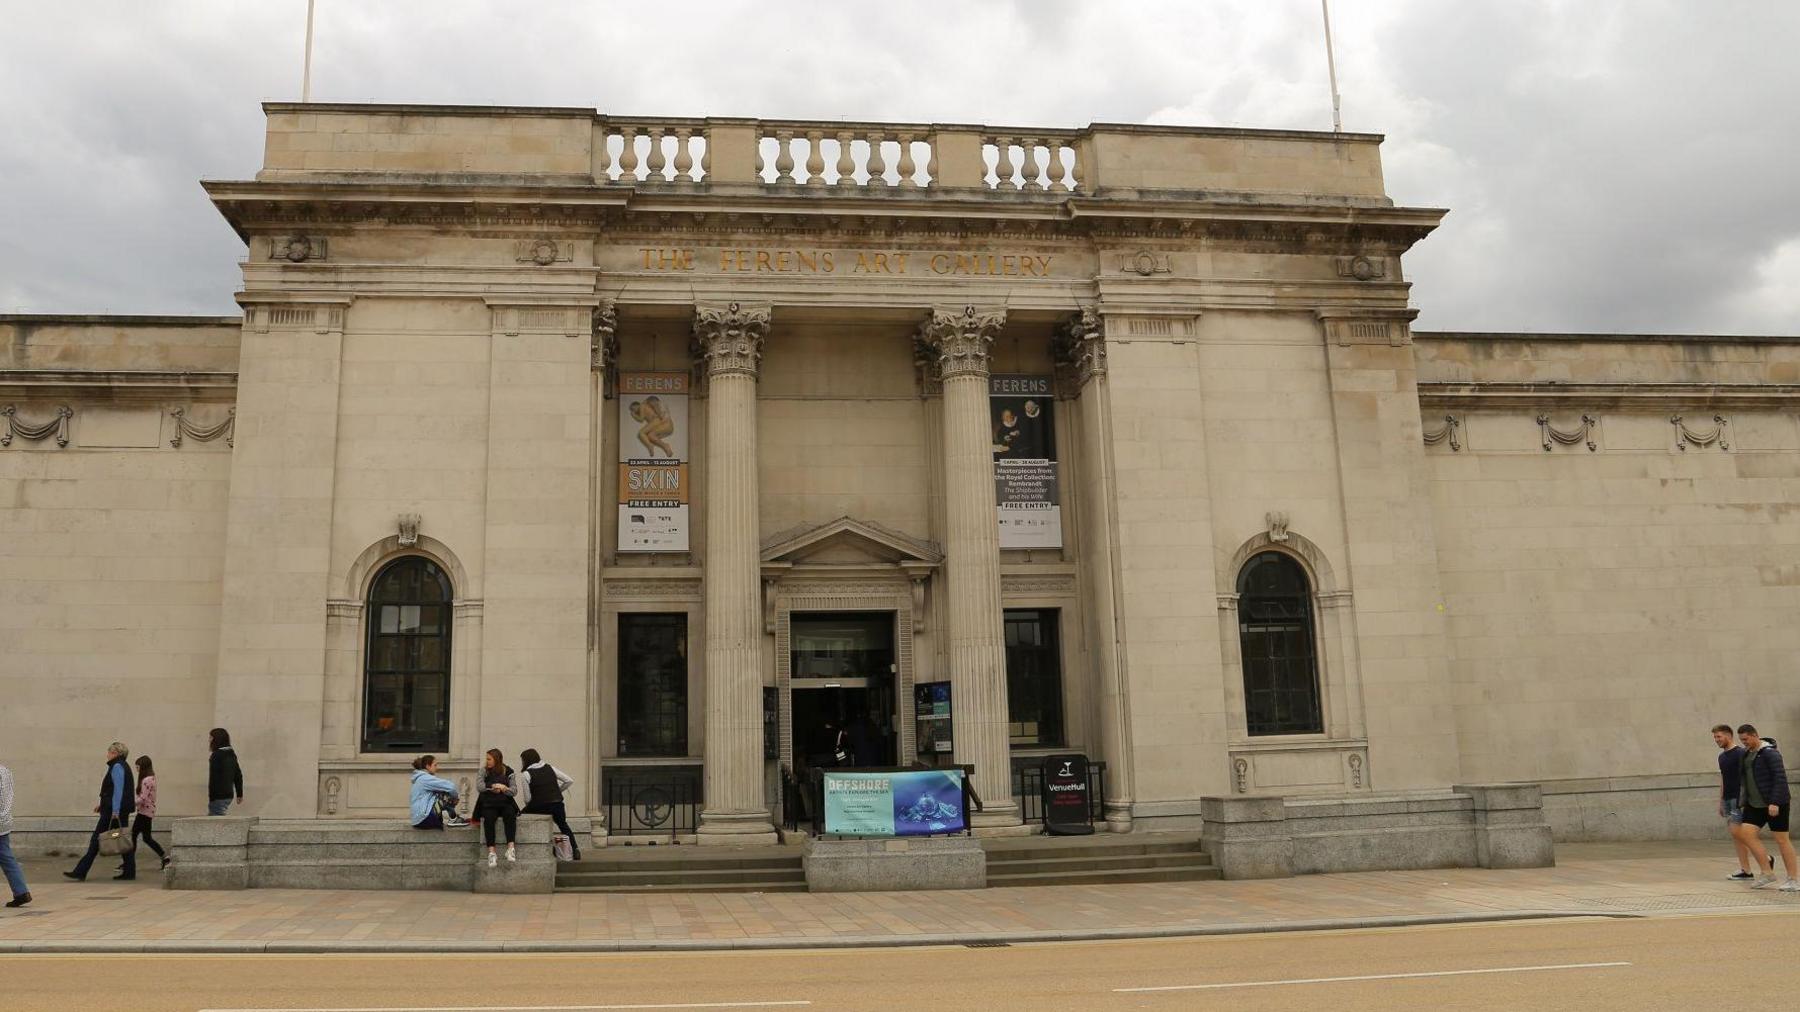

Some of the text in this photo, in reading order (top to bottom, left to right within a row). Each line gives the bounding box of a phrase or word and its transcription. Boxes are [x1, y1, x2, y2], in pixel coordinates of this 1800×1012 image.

[640, 248, 1052, 277] THE FERENS ART GALLERY
[626, 378, 683, 391] FERENS
[993, 379, 1048, 392] FERENS
[628, 469, 680, 490] SKIN
[828, 779, 889, 790] OFFSHORE
[1048, 783, 1086, 792] VenueHull
